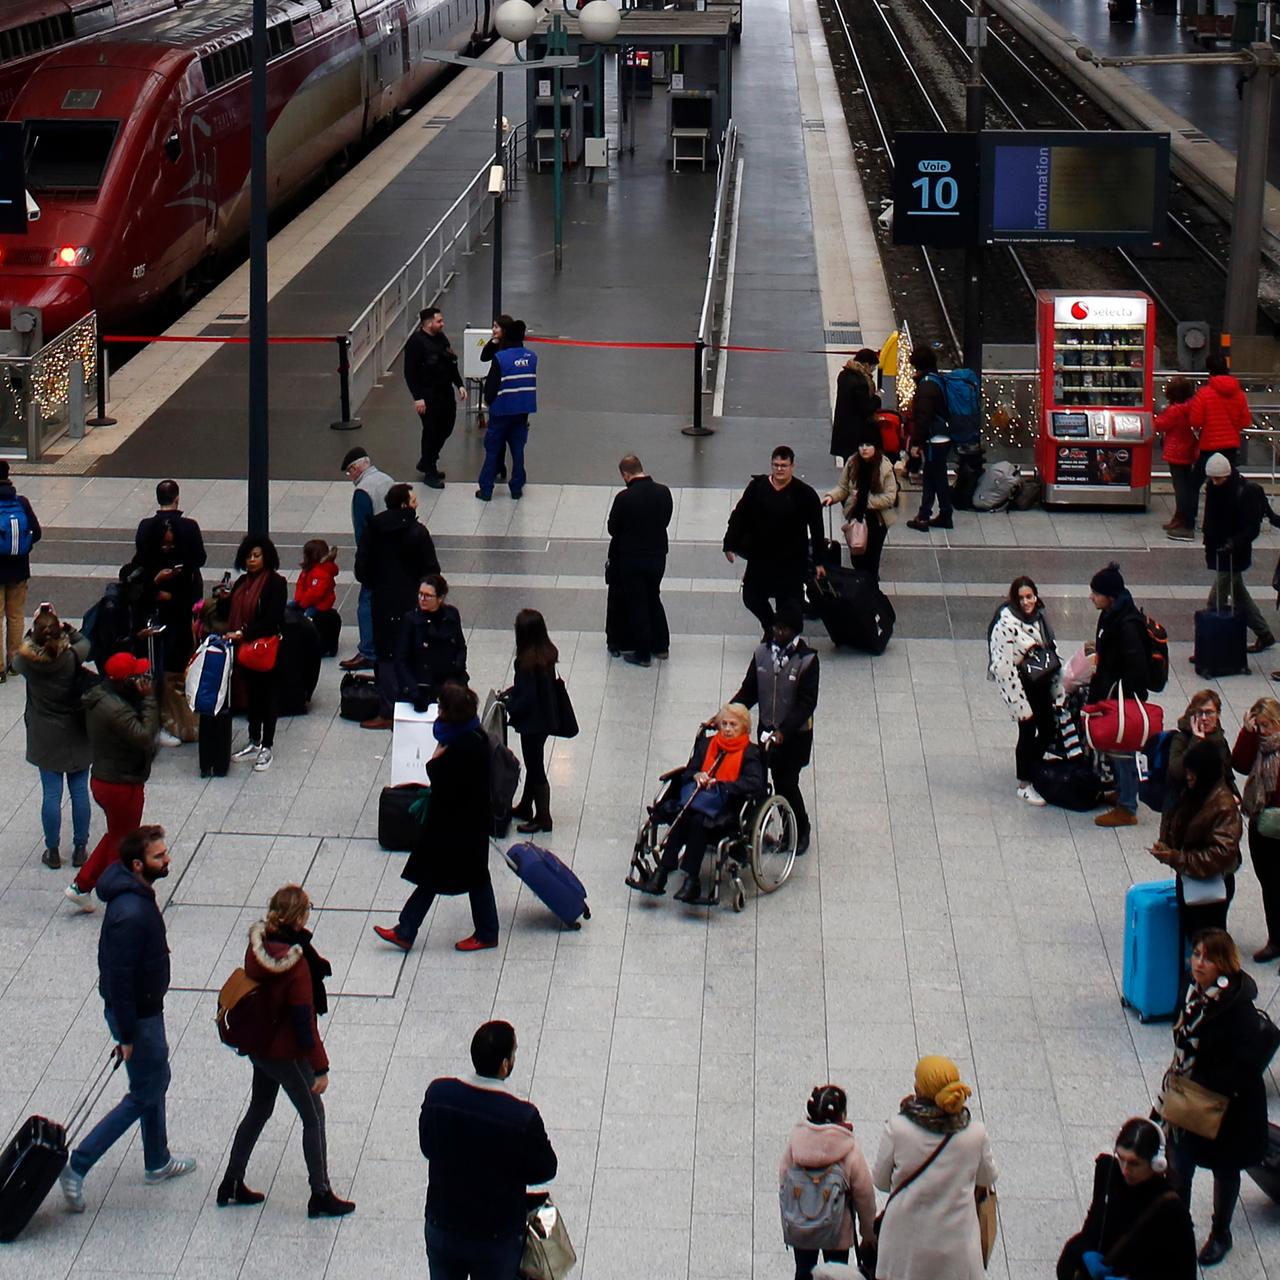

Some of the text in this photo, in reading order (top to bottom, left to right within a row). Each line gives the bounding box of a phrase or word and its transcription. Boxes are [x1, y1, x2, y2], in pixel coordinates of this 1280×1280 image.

[922, 161, 947, 172] Voie
[912, 176, 959, 210] 10
[1034, 147, 1049, 230] information
[1092, 306, 1133, 317] selecta
